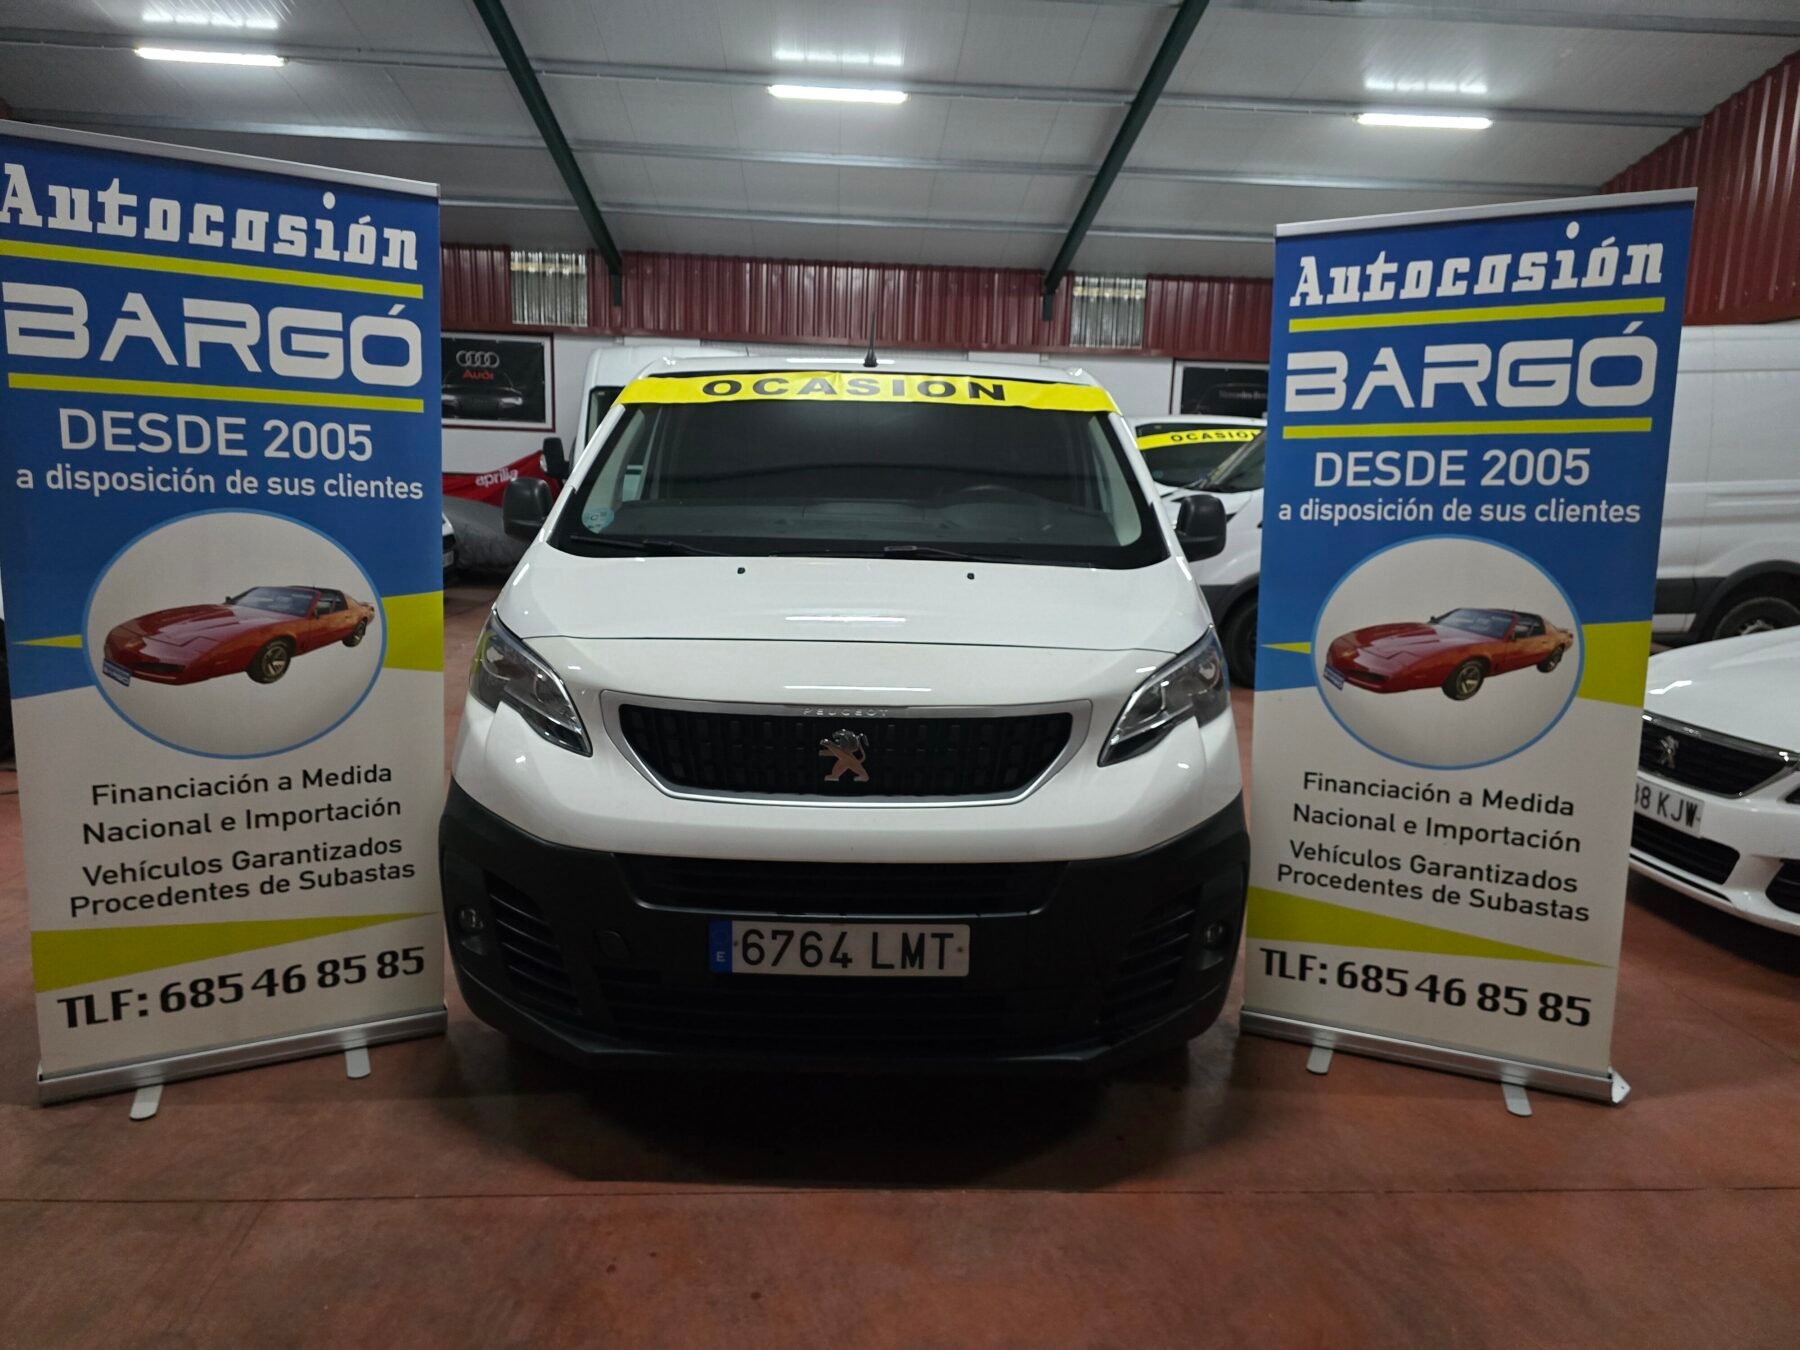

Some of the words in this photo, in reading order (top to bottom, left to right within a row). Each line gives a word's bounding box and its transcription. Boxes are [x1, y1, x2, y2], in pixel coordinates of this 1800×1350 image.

[0, 162, 418, 271] Autocasión
[1289, 221, 1664, 307] Autocasión
[1, 281, 422, 387] BARGÓ
[702, 378, 1006, 401] OCASION
[1285, 320, 1658, 413] BARGÓ
[59, 407, 248, 457] DESDE
[263, 419, 373, 462] 2005
[16, 470, 34, 489] a
[46, 463, 215, 498] disposición
[225, 470, 258, 494] de
[267, 475, 315, 497] sus
[324, 472, 423, 500] clientes
[475, 467, 518, 488] aprilia
[1314, 449, 1468, 488] DESDE
[1480, 447, 1591, 486] 2005
[1278, 505, 1291, 521] a
[1300, 498, 1433, 526] disposición
[1442, 499, 1471, 521] de
[1480, 505, 1526, 522] sus
[1535, 499, 1641, 523] clientes
[91, 773, 269, 807] Financiación
[277, 773, 292, 791] a
[302, 764, 392, 789] Medida
[1303, 772, 1450, 806] Financiación
[1458, 791, 1472, 807] a
[1482, 789, 1575, 817] Medida
[82, 813, 211, 845] Nacional
[221, 816, 236, 831] e
[246, 798, 401, 832] Importación
[1292, 804, 1396, 834] Nacional
[1404, 819, 1417, 835] e
[1425, 817, 1581, 853] Importación
[82, 853, 223, 887] Vehículos
[231, 837, 402, 872] Garantizados
[1289, 839, 1401, 872] Vehículos
[1410, 855, 1578, 894] Garantizados
[70, 880, 250, 918] Procedentes
[259, 874, 290, 895] de
[299, 861, 416, 890] Subastas
[1277, 864, 1423, 901] Procedentes
[1432, 881, 1461, 906] de
[1469, 889, 1590, 922] Subastas
[716, 951, 725, 962] E
[741, 929, 852, 969] 6764
[871, 932, 954, 970] LMT
[57, 987, 149, 1029] TLF:
[159, 973, 245, 1014] 685
[250, 964, 307, 998] 46
[317, 954, 368, 989] 85
[376, 946, 425, 980] 85
[1260, 948, 1328, 985] TLF:
[1336, 961, 1409, 998] 685
[1414, 972, 1466, 1007] 46
[1477, 982, 1528, 1017] 85
[1538, 991, 1592, 1027] 85
